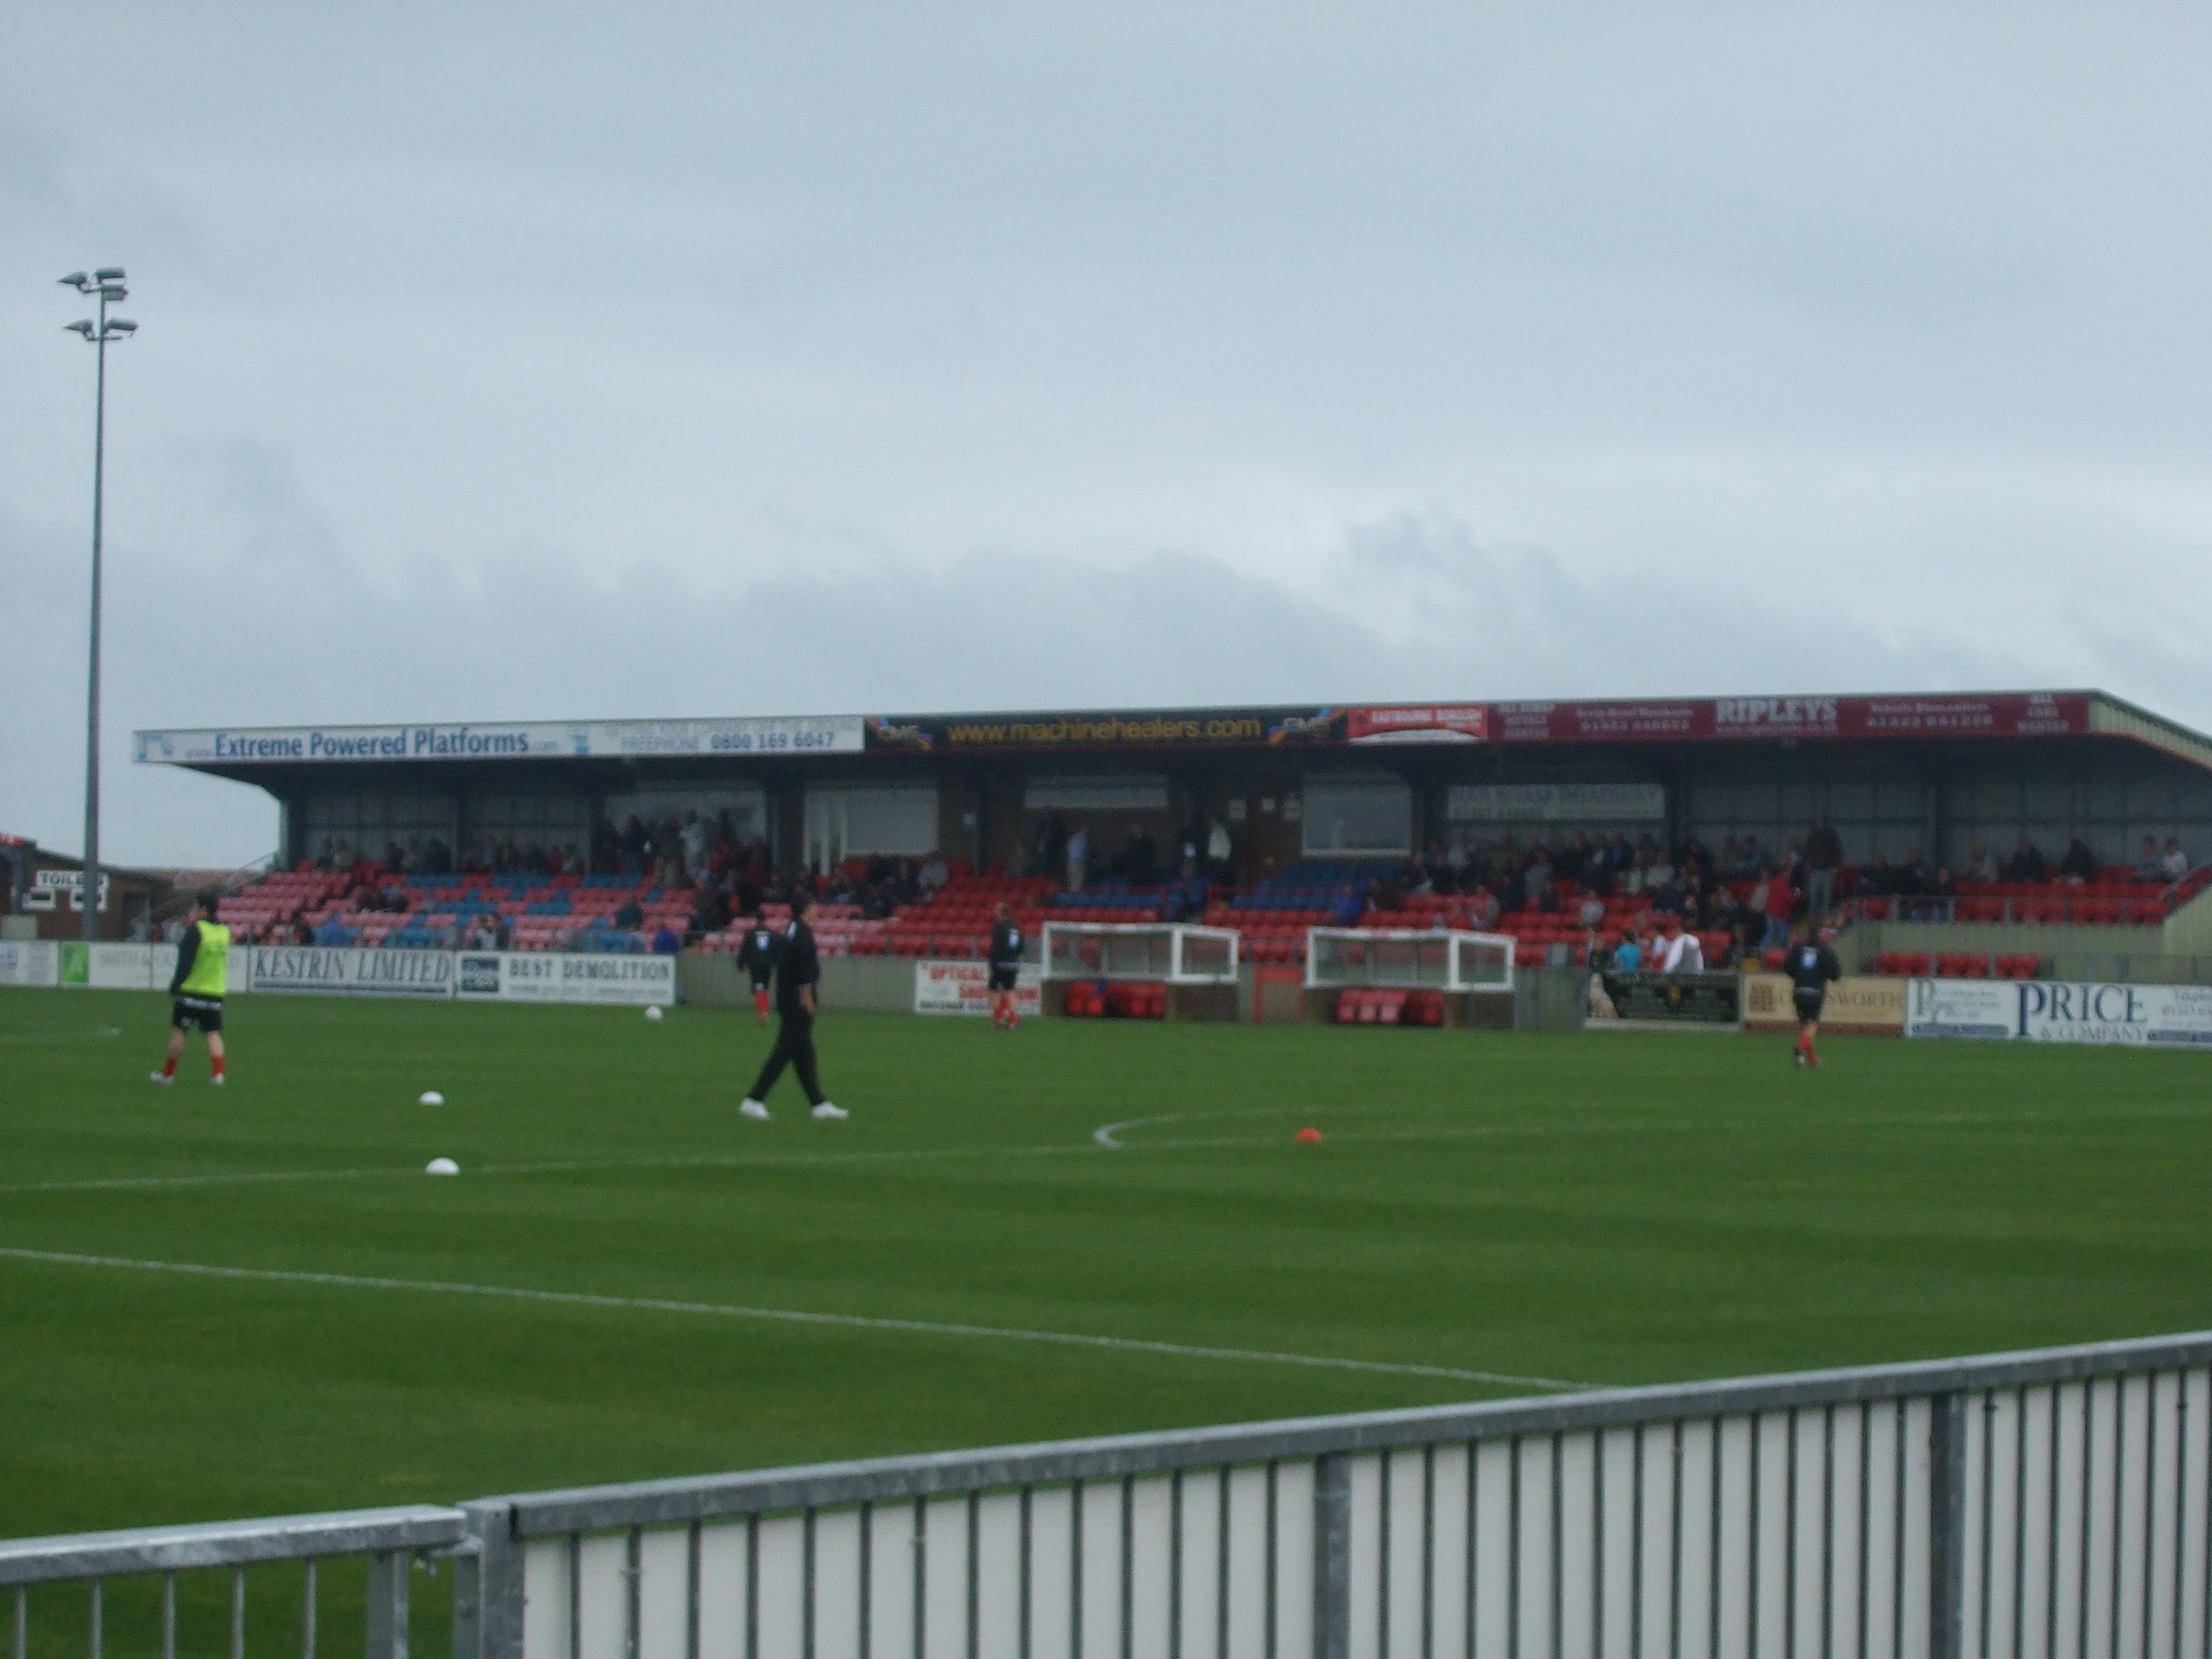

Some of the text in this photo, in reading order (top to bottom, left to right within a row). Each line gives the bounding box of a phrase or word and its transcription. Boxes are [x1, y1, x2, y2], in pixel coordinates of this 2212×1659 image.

[1716, 700, 1838, 722] RIPLEYS
[215, 732, 302, 756] Extreme
[311, 728, 406, 756] Powered
[415, 727, 529, 753] Platforms
[711, 732, 751, 750] 0800
[758, 732, 787, 749] 169
[793, 730, 835, 747] 6047
[254, 949, 350, 979] KESTRIN
[355, 951, 450, 983] LIMITED
[509, 958, 553, 979] BEST
[562, 960, 670, 981] DEMOLITION
[2015, 983, 2147, 1036] PRICE
[2060, 1026, 2144, 1041] COMPANY
